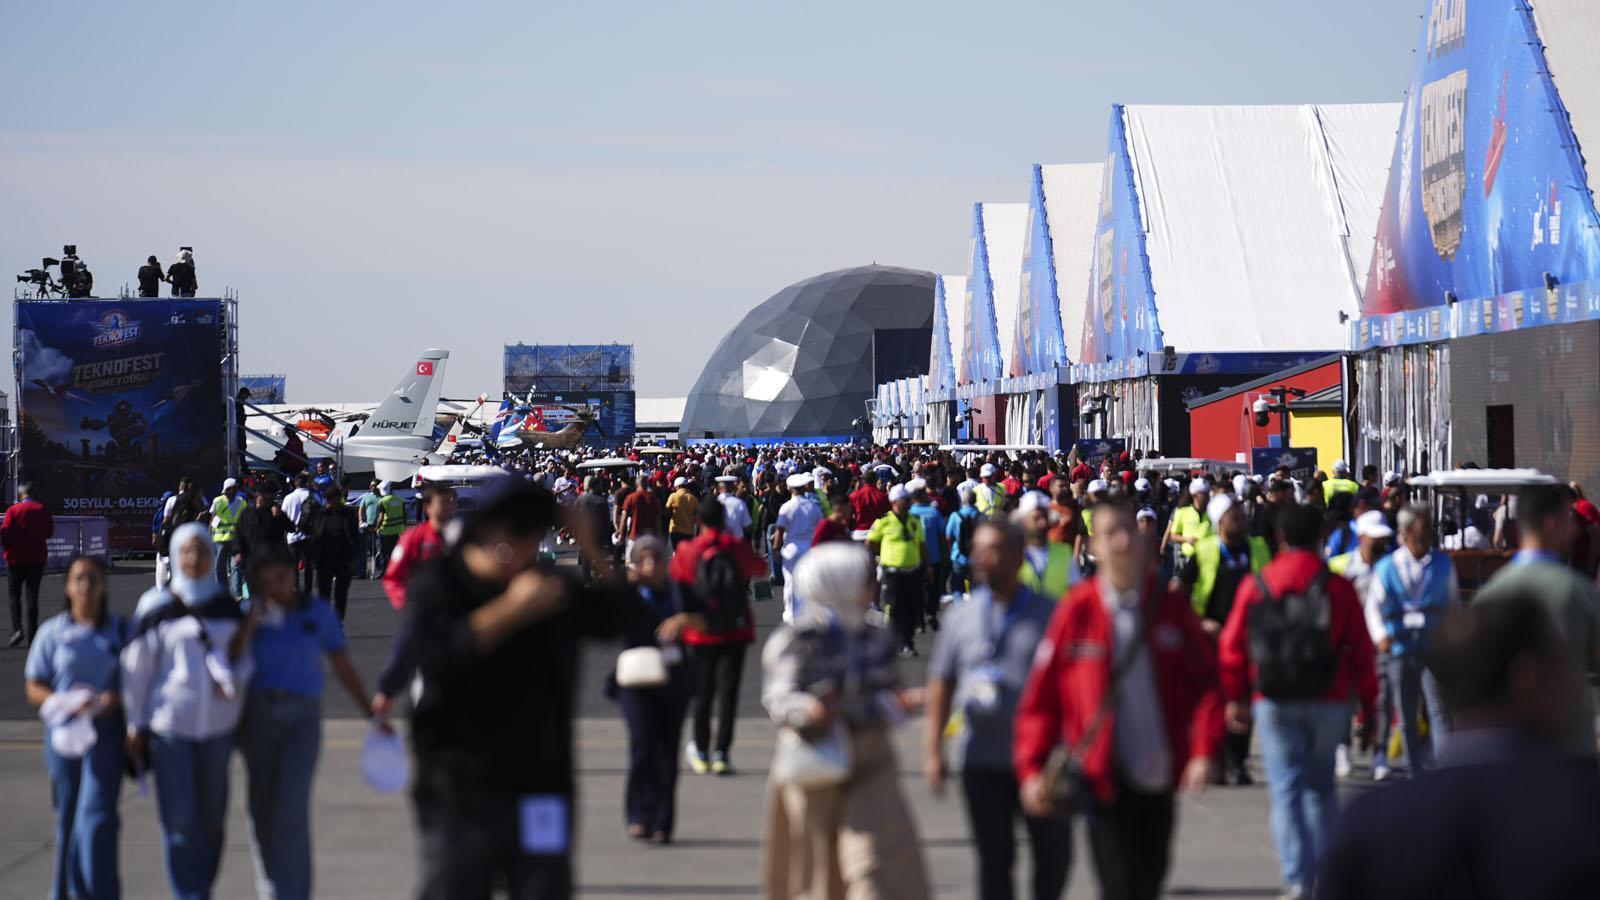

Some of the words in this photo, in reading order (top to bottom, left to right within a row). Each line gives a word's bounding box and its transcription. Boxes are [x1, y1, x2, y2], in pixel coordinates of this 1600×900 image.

[74, 353, 163, 381] TEKNOFEST
[372, 420, 418, 429] HÜRJET
[63, 498, 78, 508] 30
[118, 497, 135, 508] 04
